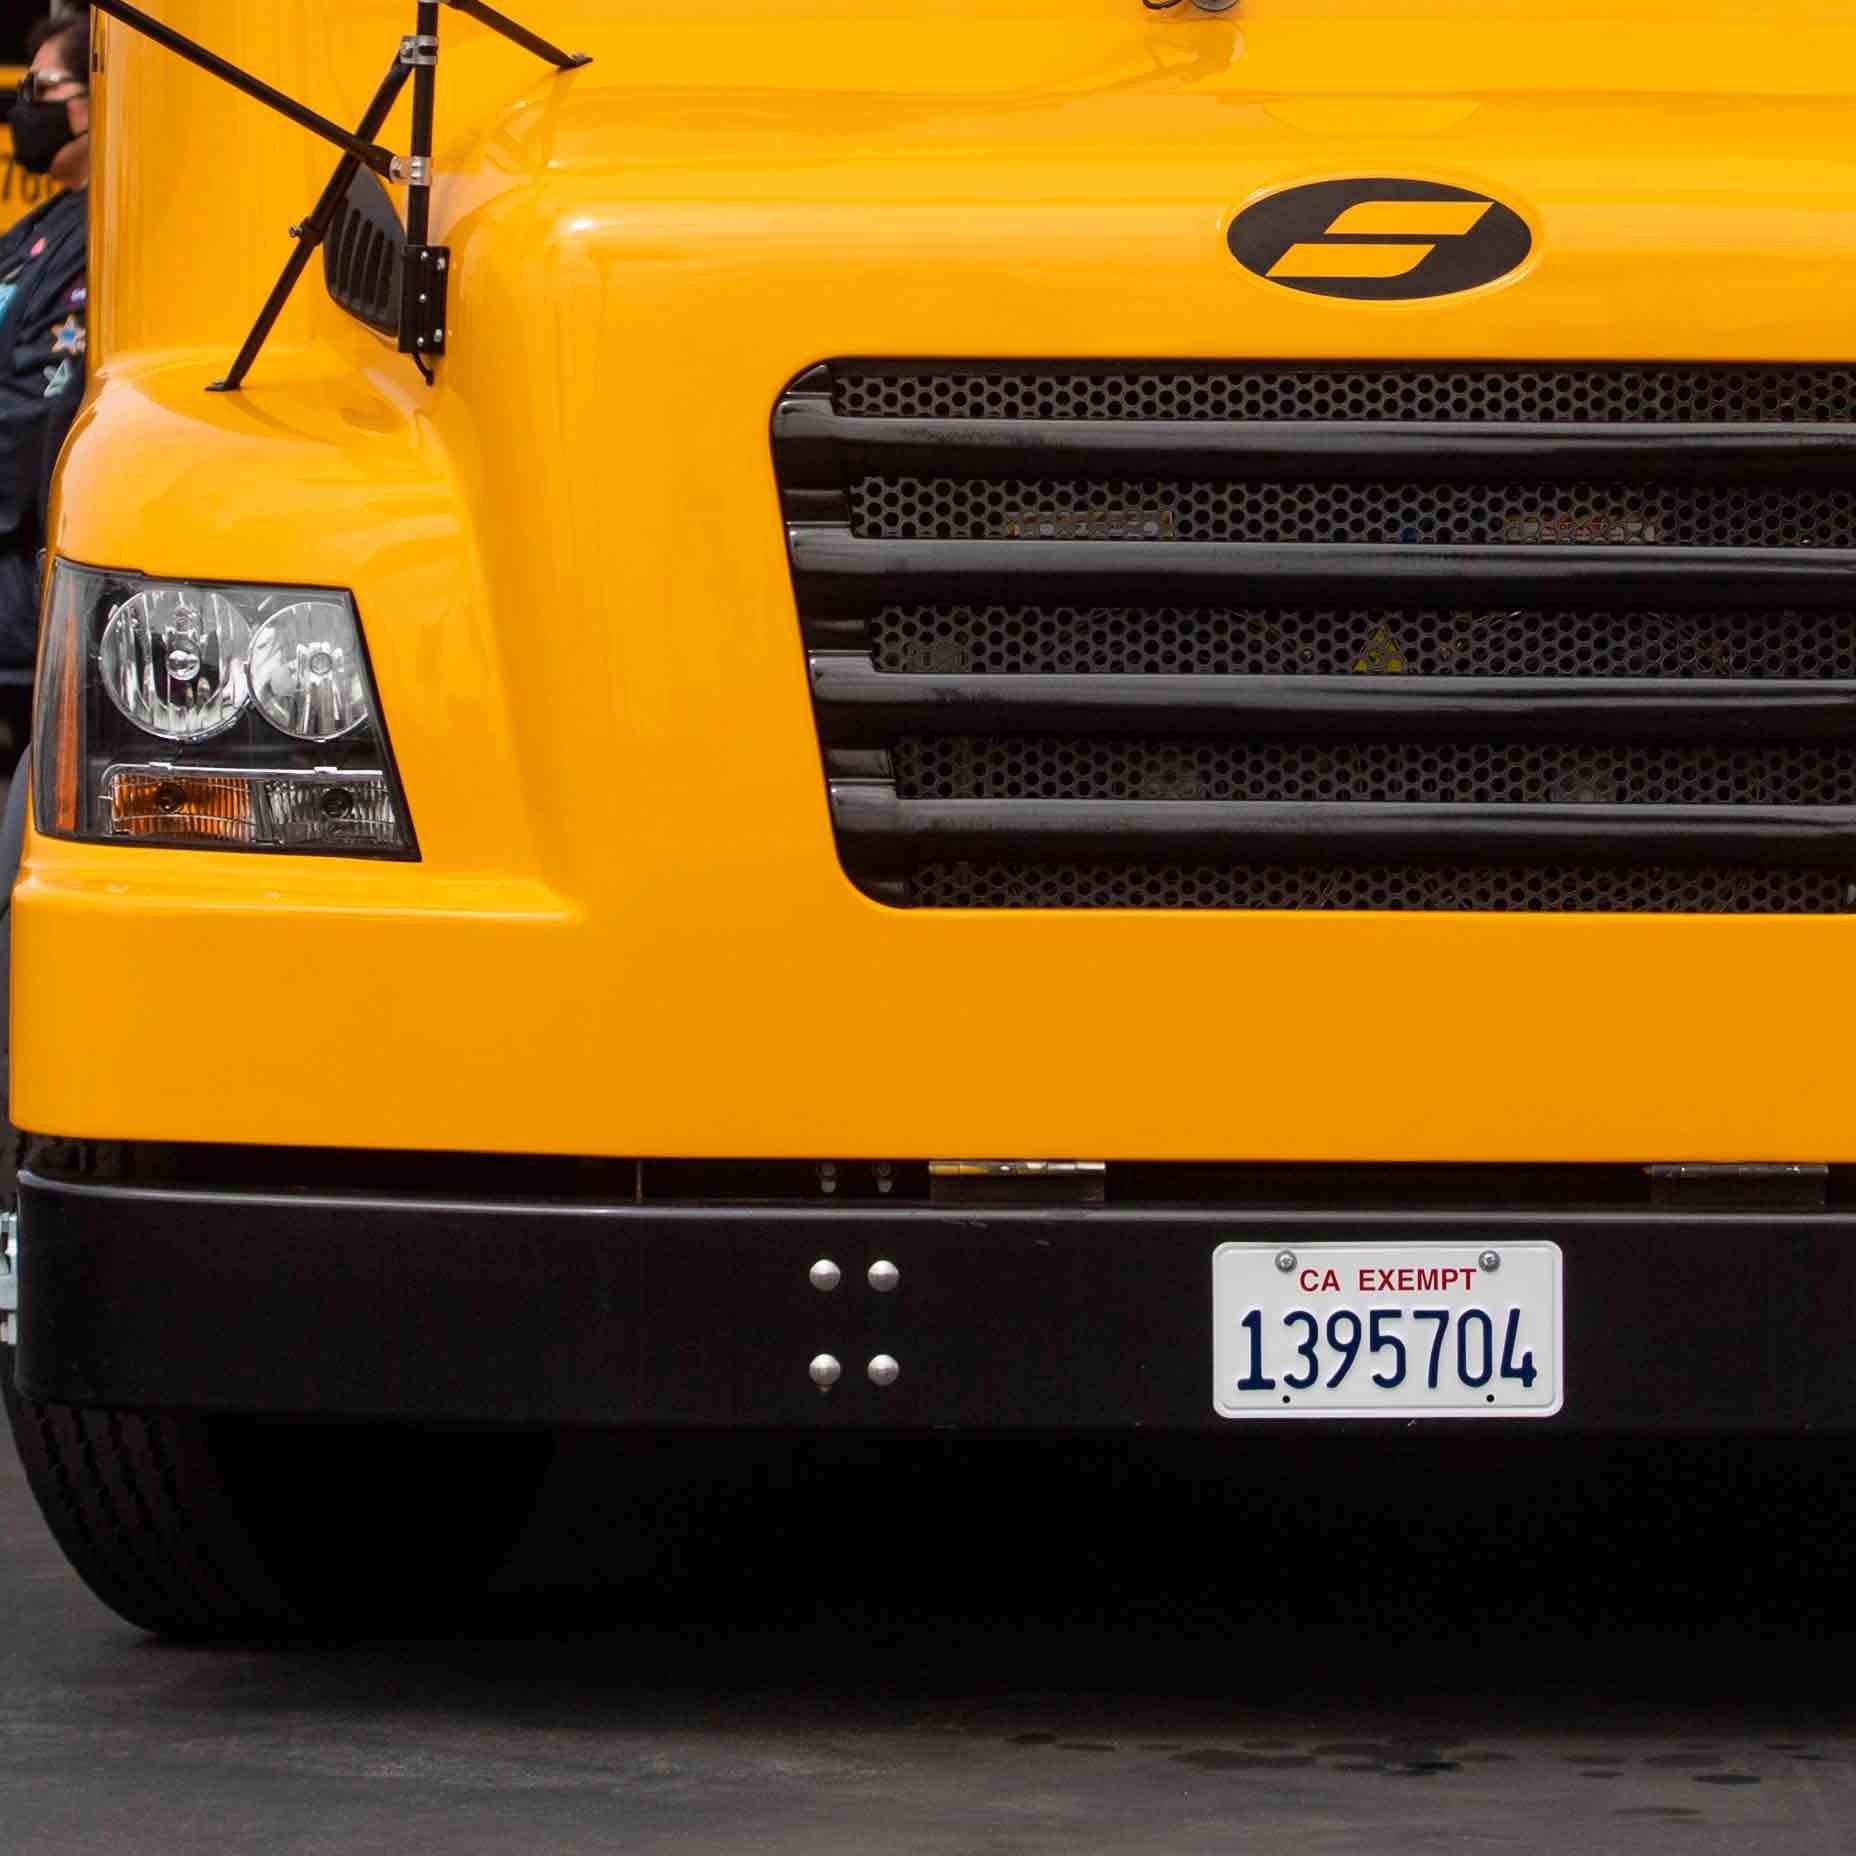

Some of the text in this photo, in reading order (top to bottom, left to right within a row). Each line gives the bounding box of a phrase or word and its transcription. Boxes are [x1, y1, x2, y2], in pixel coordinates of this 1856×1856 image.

[1299, 1267, 1477, 1293] CA EXEMPT
[1237, 1307, 1538, 1391] 1395704
